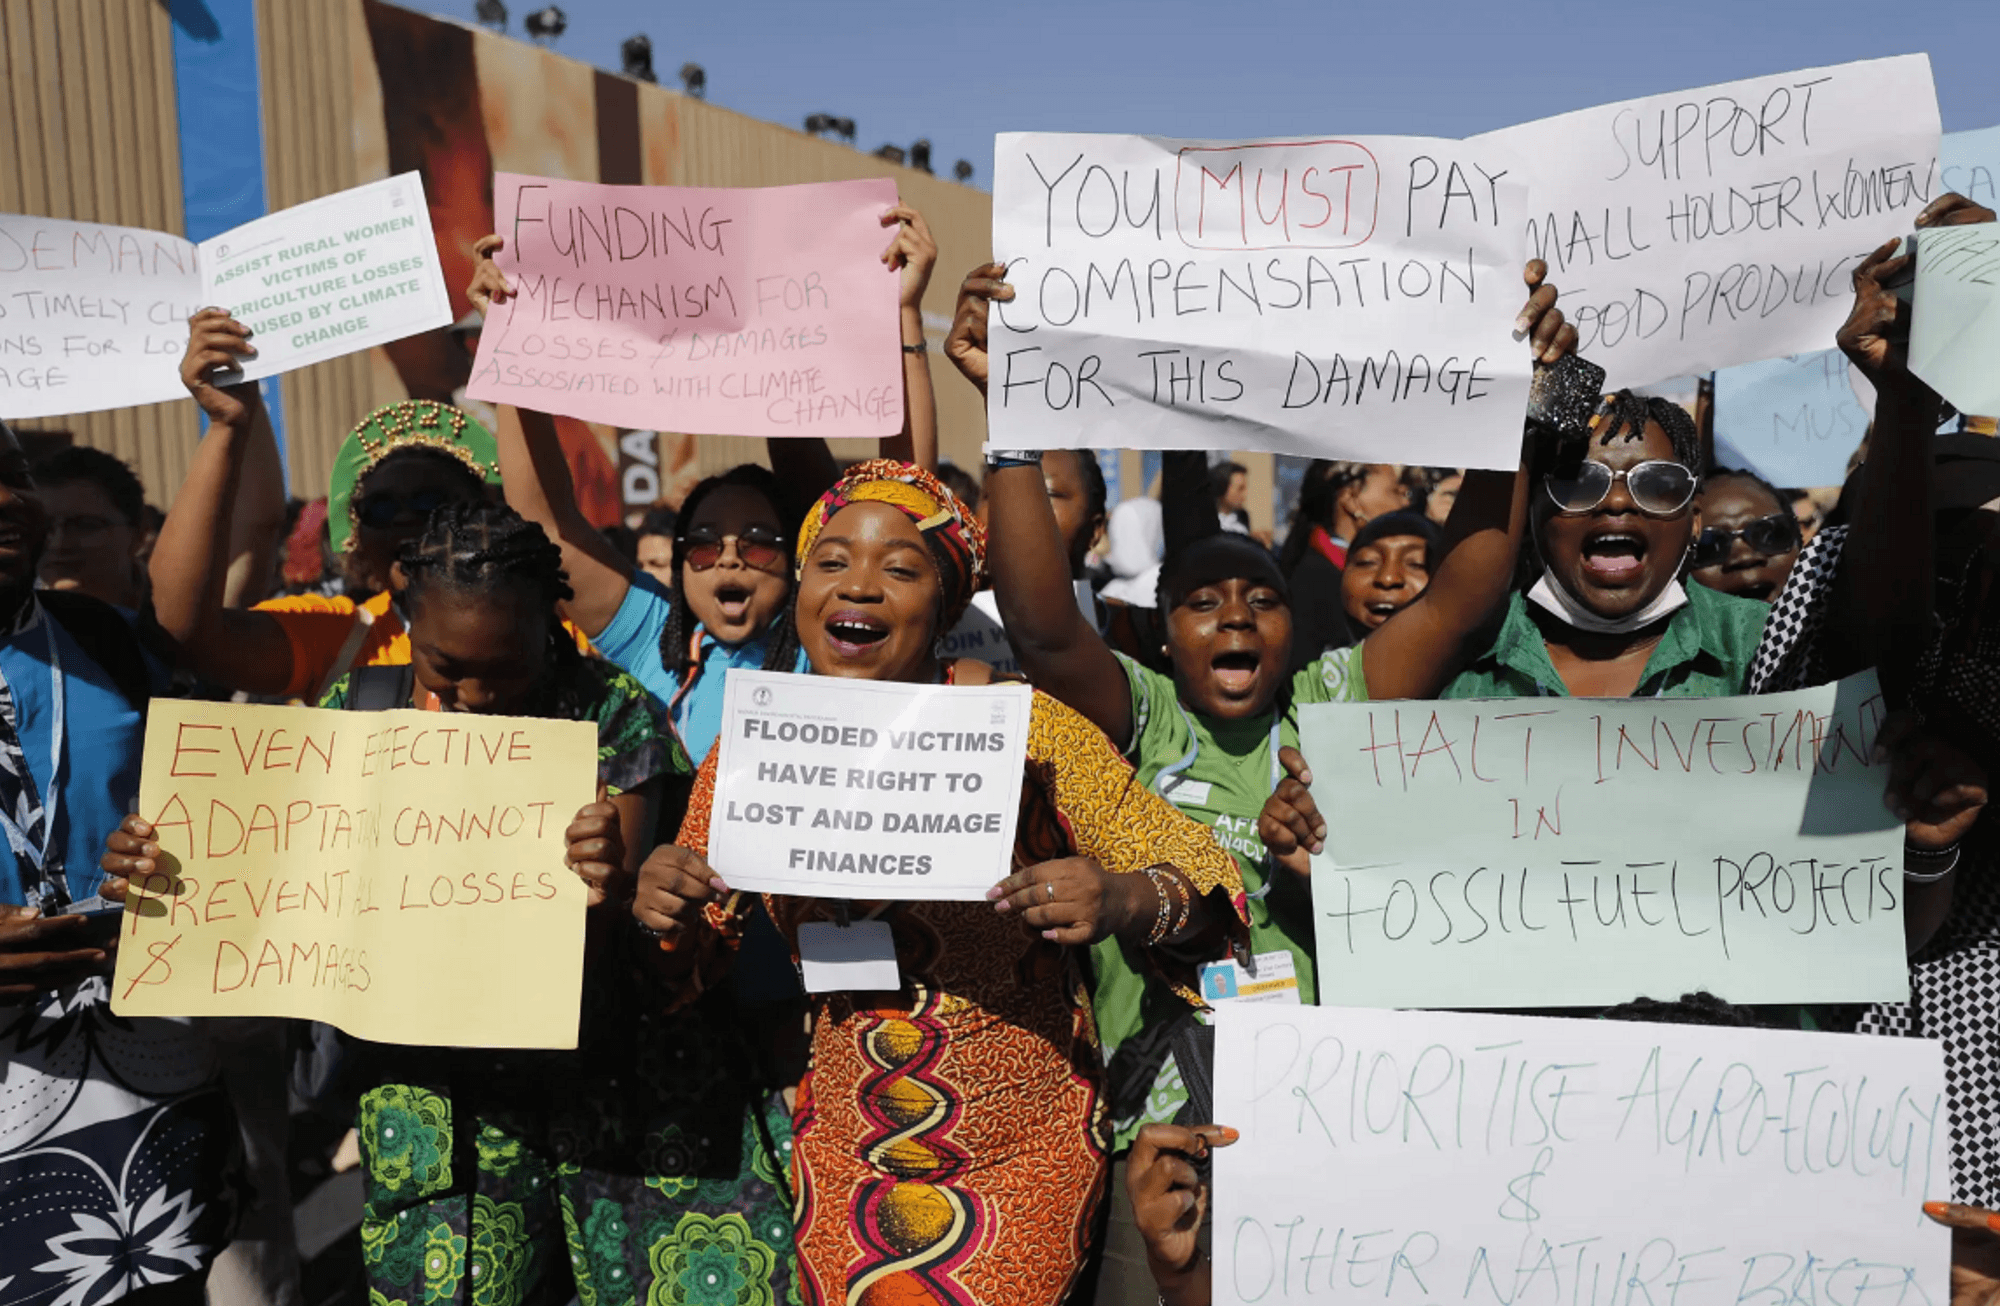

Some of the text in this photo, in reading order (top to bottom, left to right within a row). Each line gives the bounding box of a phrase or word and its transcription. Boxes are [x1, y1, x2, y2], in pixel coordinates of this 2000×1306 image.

[1606, 76, 1832, 181] SUPPORT
[515, 185, 732, 268] FUNDING
[1026, 153, 1508, 247] YOU MUST PAY
[1526, 157, 1936, 274] MALL HOLDER WOMEN
[0, 227, 197, 275] DEMAN
[214, 255, 273, 286] ASSIST
[278, 236, 340, 262] RURAL
[344, 215, 415, 243] WOMEN
[262, 249, 367, 287] VICTIMS OF
[12, 291, 129, 325] TIMELY
[231, 257, 424, 318] GRICULTURE LOSSES
[308, 302, 333, 320] BY
[339, 279, 421, 311] CLIMATE
[508, 271, 829, 326] MECHANISM FOR
[997, 247, 1475, 334] COMPENSATION
[1556, 288, 1668, 353] OOD
[1681, 251, 1875, 341] PRODUC
[2, 335, 190, 357] NS FOR LO
[291, 317, 370, 349] CHANGE
[494, 329, 637, 360] LOSSES
[687, 325, 828, 361] DAMAGES
[654, 374, 711, 397] WITH
[719, 367, 827, 399] CLIMATE
[767, 385, 897, 425] CHANGE
[1003, 346, 1495, 410] FOR THIS DAMAGE
[170, 722, 336, 777] EVEN
[743, 718, 1005, 752] FLOODED VICTIMS
[1360, 709, 1561, 792] HALT
[757, 762, 983, 793] HAVE RIGHT TO
[393, 801, 554, 847] CANNOT
[727, 800, 1002, 833] LOST AND DAMAGE
[1508, 785, 1563, 841] IN
[788, 848, 933, 876] FINANCES
[132, 870, 349, 936] PREVENT
[400, 871, 558, 910] LOSSES
[1327, 851, 1897, 960] FOSSIL FUEL PROJECTS
[1244, 1022, 1598, 1154] PRIORITISE
[1232, 1214, 1440, 1303] OTHER
